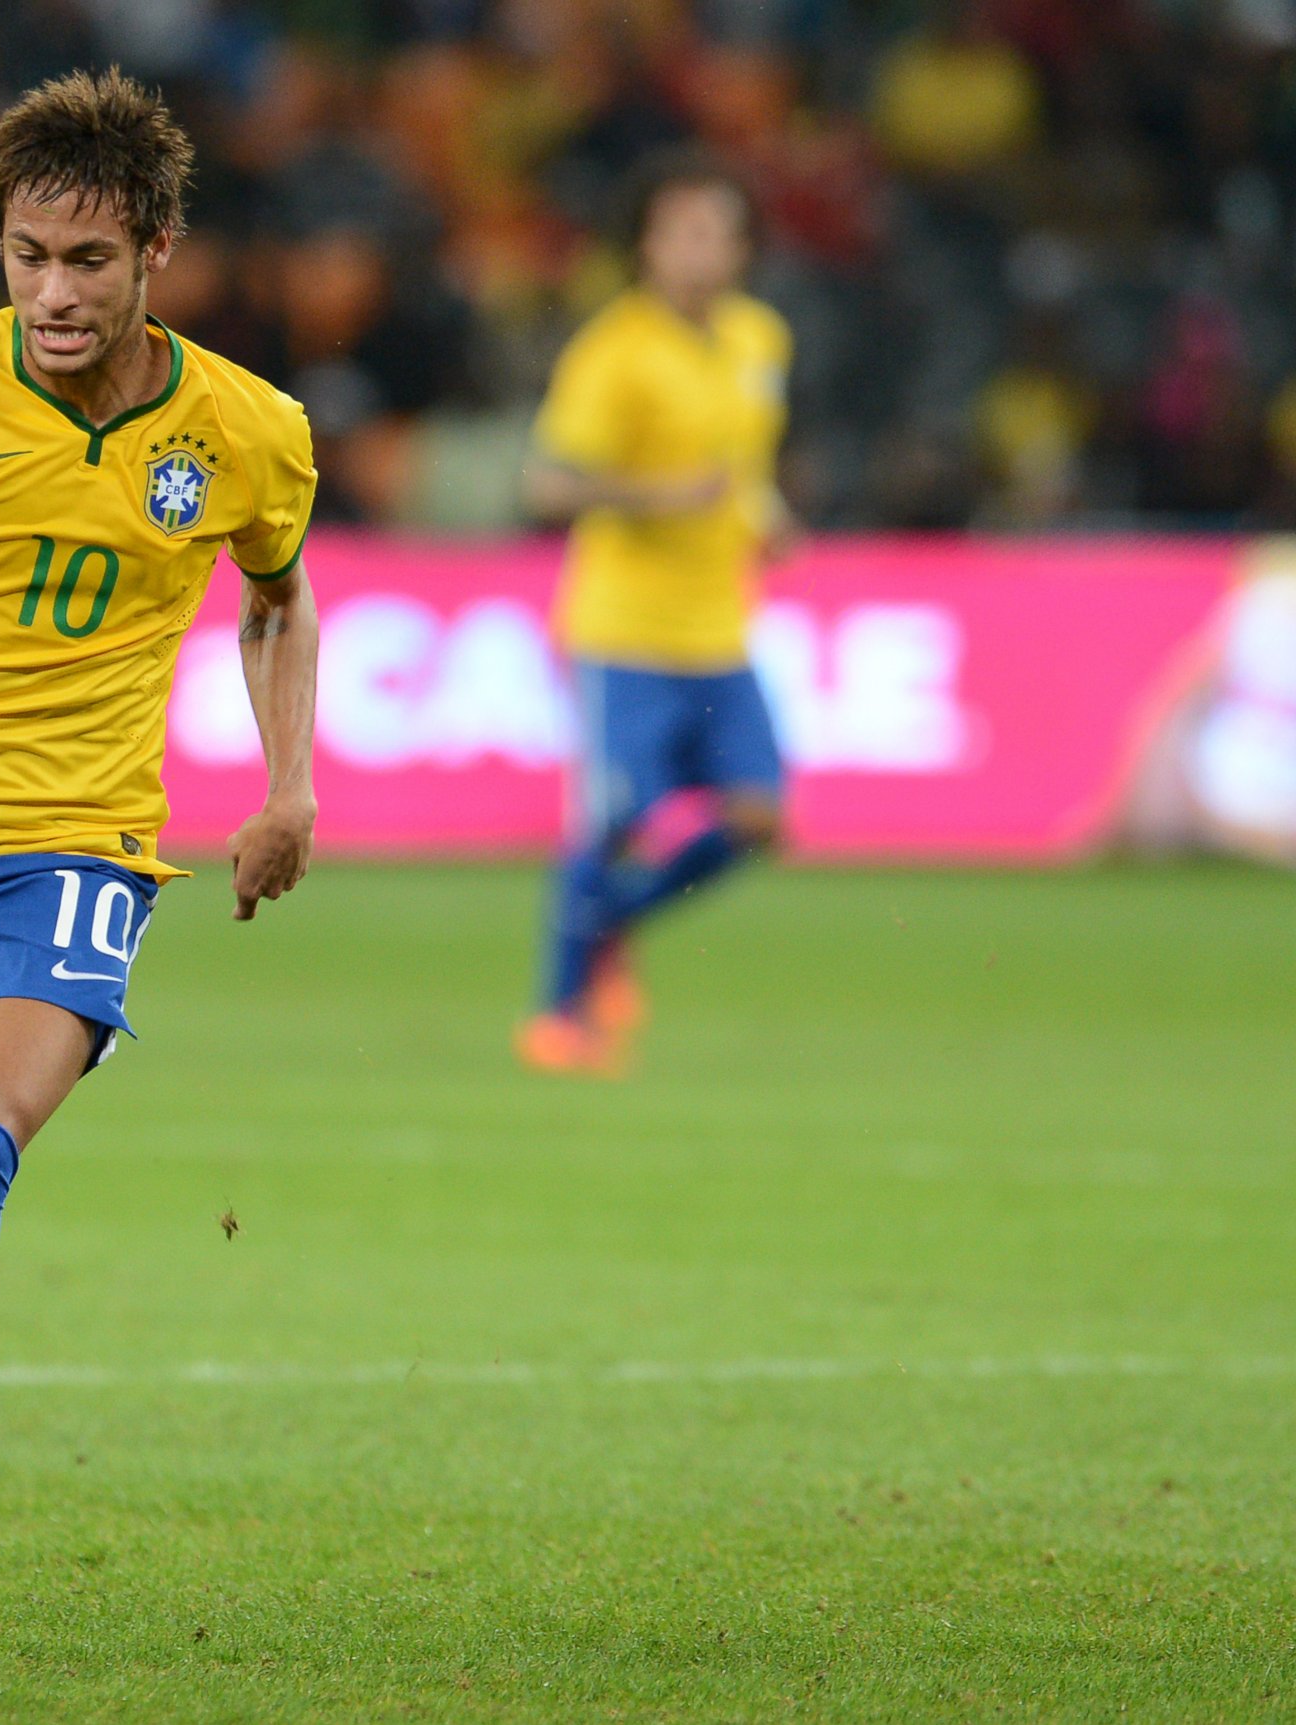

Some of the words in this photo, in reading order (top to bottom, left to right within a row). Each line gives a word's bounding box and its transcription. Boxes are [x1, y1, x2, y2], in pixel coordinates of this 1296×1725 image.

[165, 484, 189, 496] CBF
[18, 534, 120, 638] 10
[52, 869, 135, 964] 10
